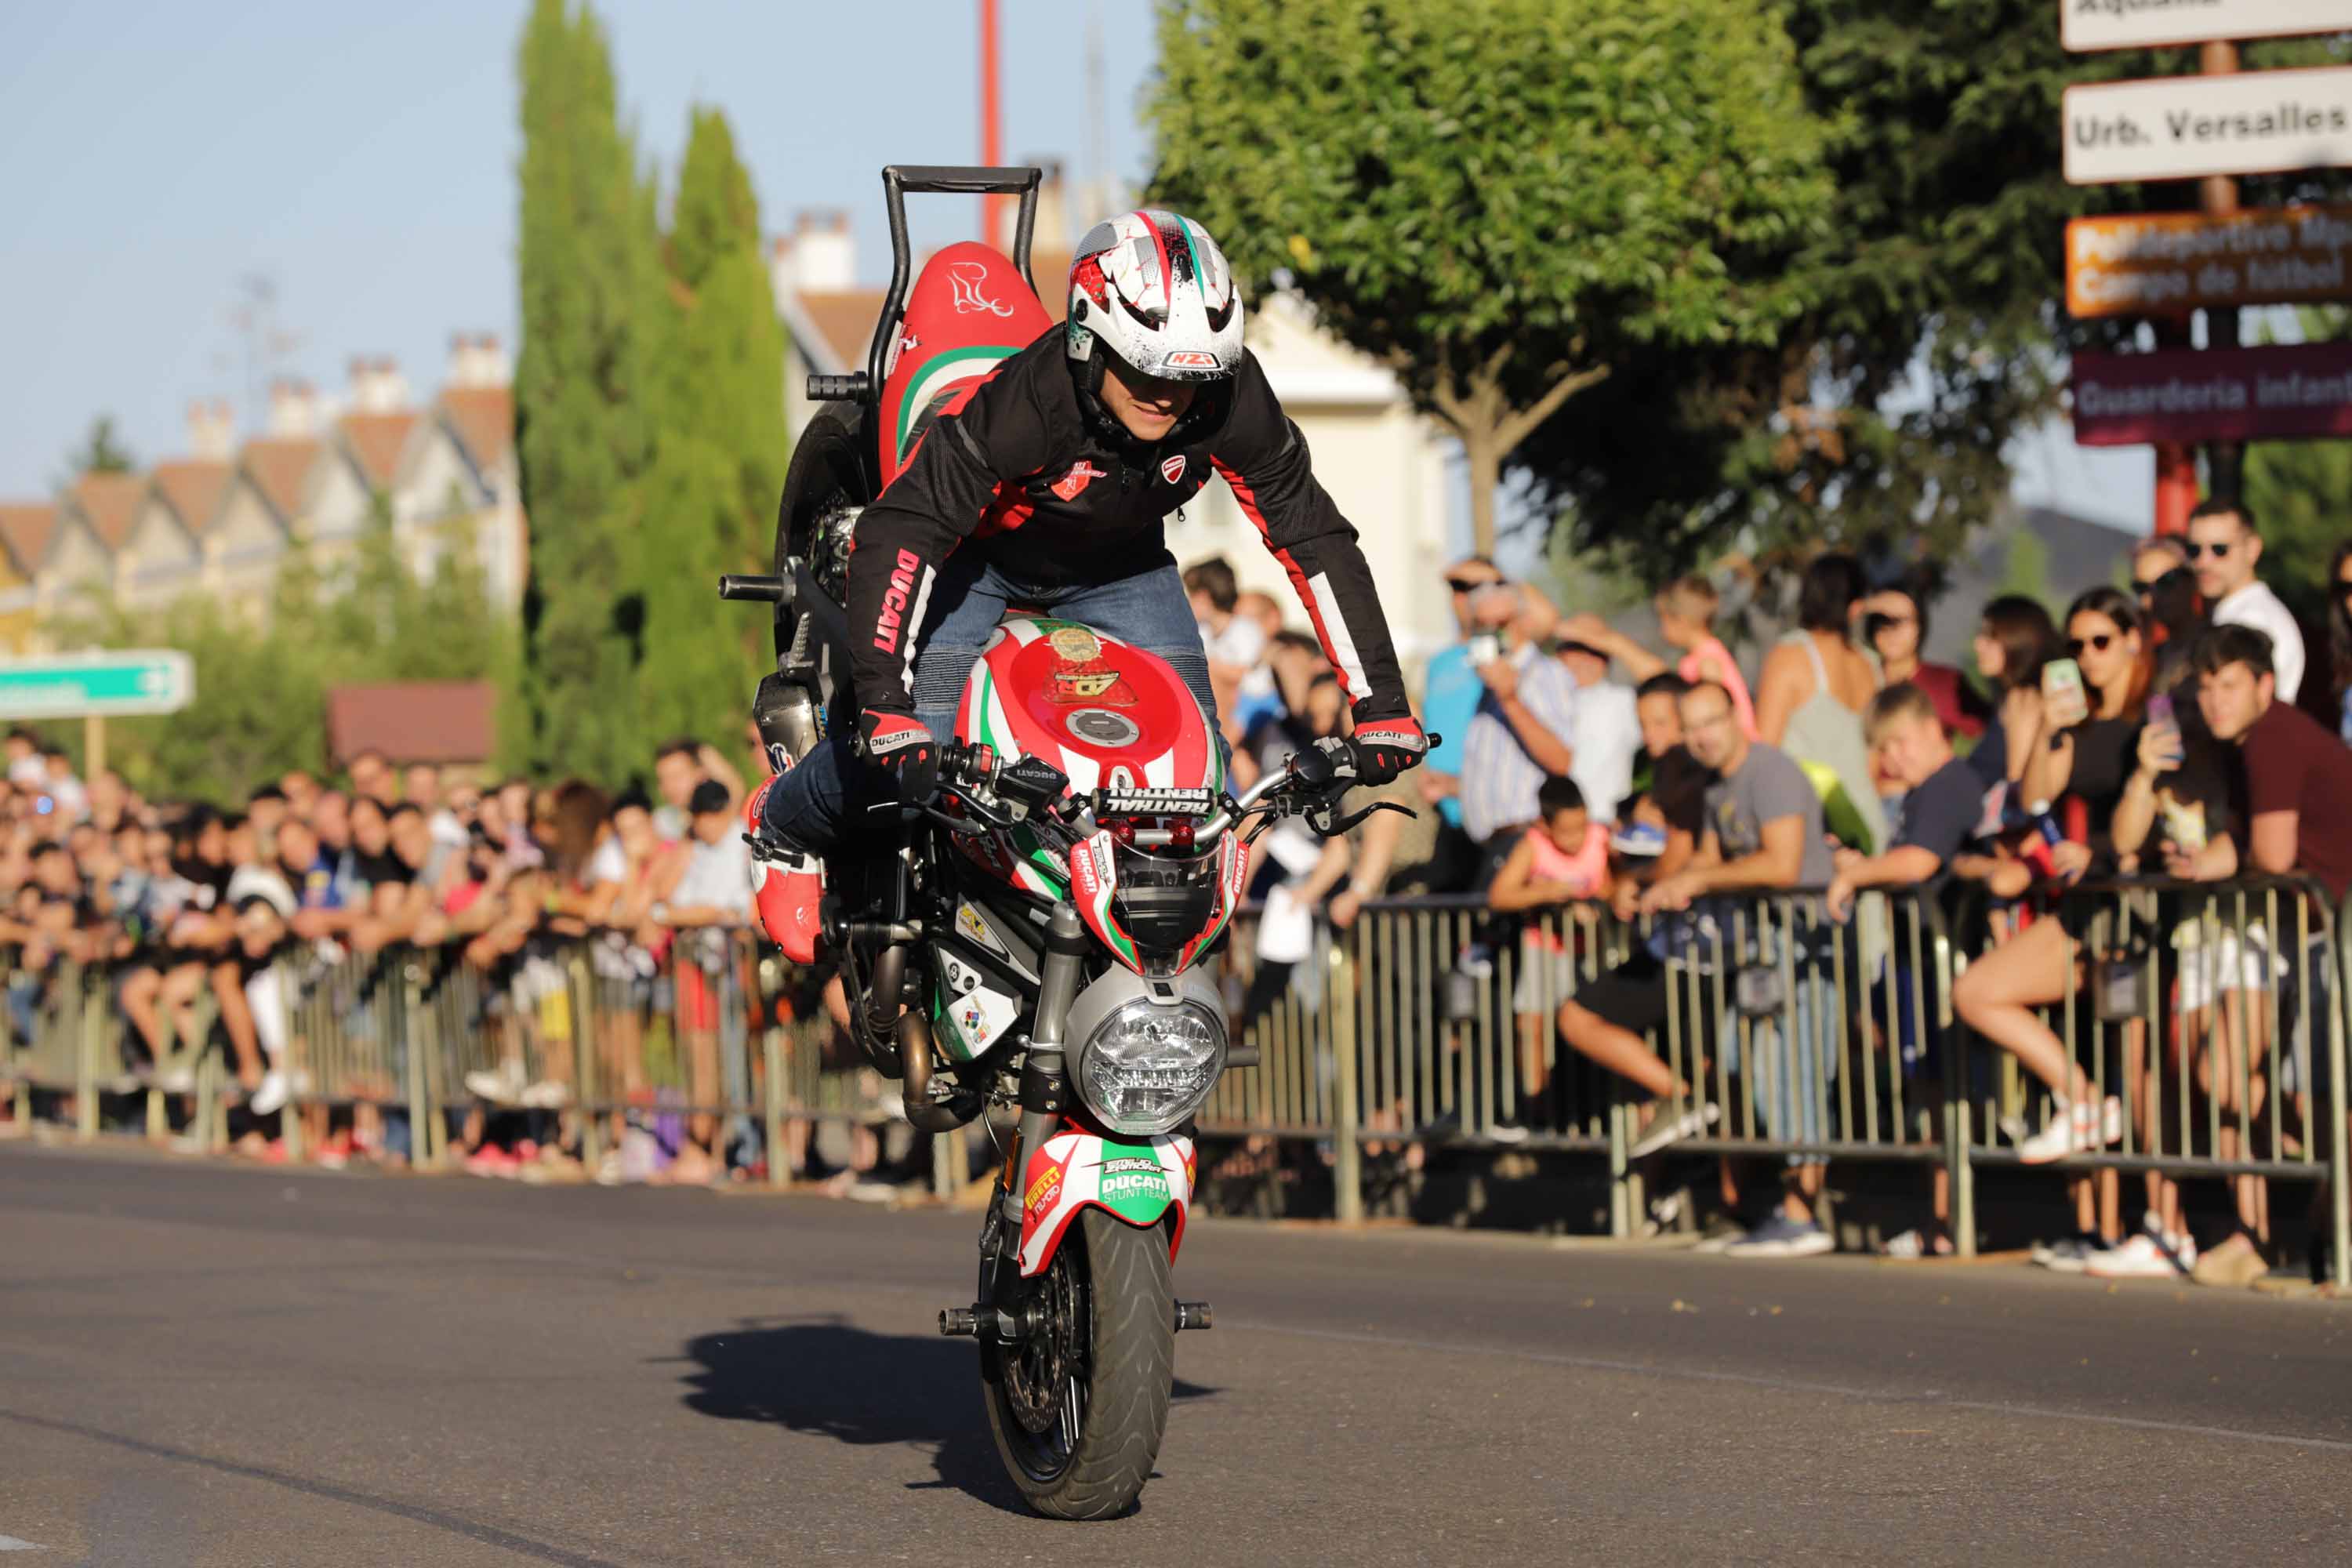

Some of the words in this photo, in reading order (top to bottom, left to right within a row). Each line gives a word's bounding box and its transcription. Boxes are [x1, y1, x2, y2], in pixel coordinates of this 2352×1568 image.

[2074, 115, 2151, 147] Urb.
[2165, 103, 2346, 142] Versalles
[873, 547, 920, 655] DUCATI
[871, 731, 910, 747] DUCATI
[1359, 731, 1401, 741] DUCATI
[1016, 768, 1058, 779] DUCATI
[1106, 798, 1210, 815] RENTHAL
[1078, 849, 1098, 892] DUCATI
[1233, 848, 1245, 895] DUCATI
[1025, 1166, 1061, 1210] PIRELLI
[1102, 1174, 1167, 1194] DUCATI
[1103, 1188, 1142, 1204] STUNT
[1145, 1188, 1170, 1202] TEAM
